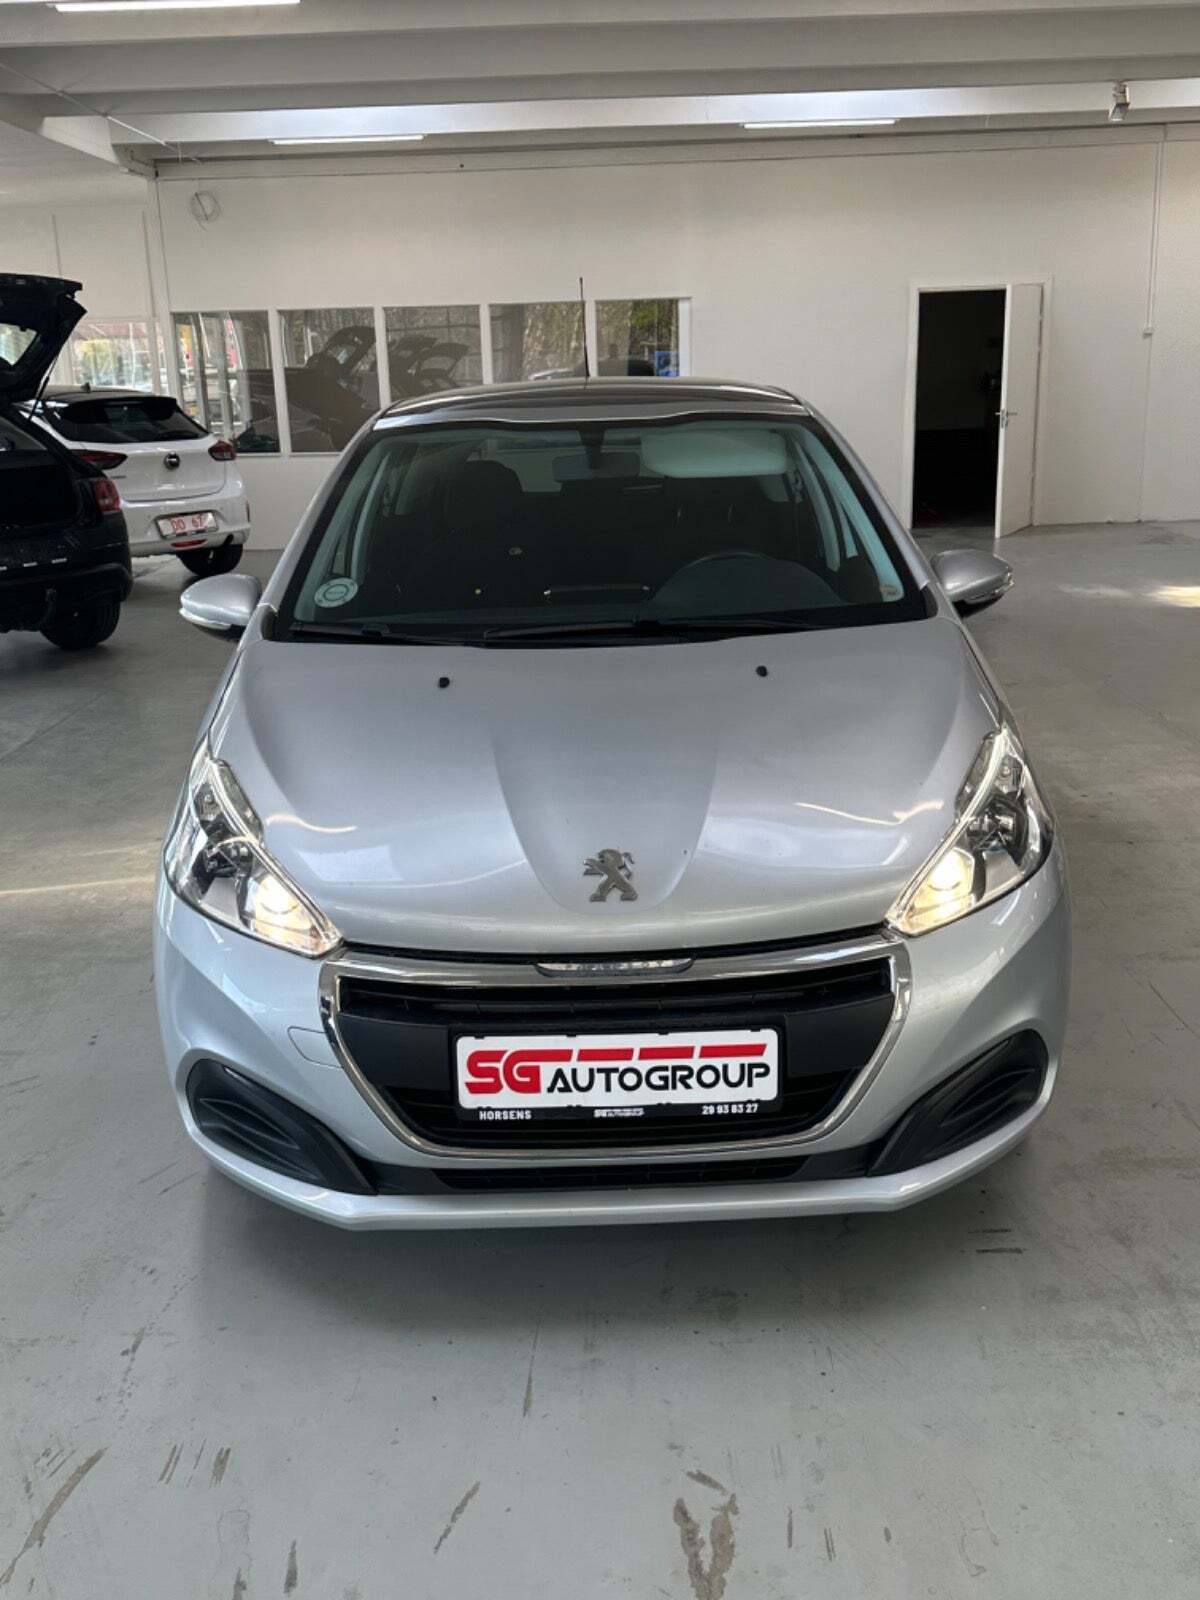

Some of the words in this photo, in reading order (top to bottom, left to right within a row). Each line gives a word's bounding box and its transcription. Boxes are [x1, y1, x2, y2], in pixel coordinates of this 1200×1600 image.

[465, 1049, 573, 1094] SG
[547, 1062, 770, 1094] AUTOGROUP
[479, 1110, 532, 1121] HORSENS
